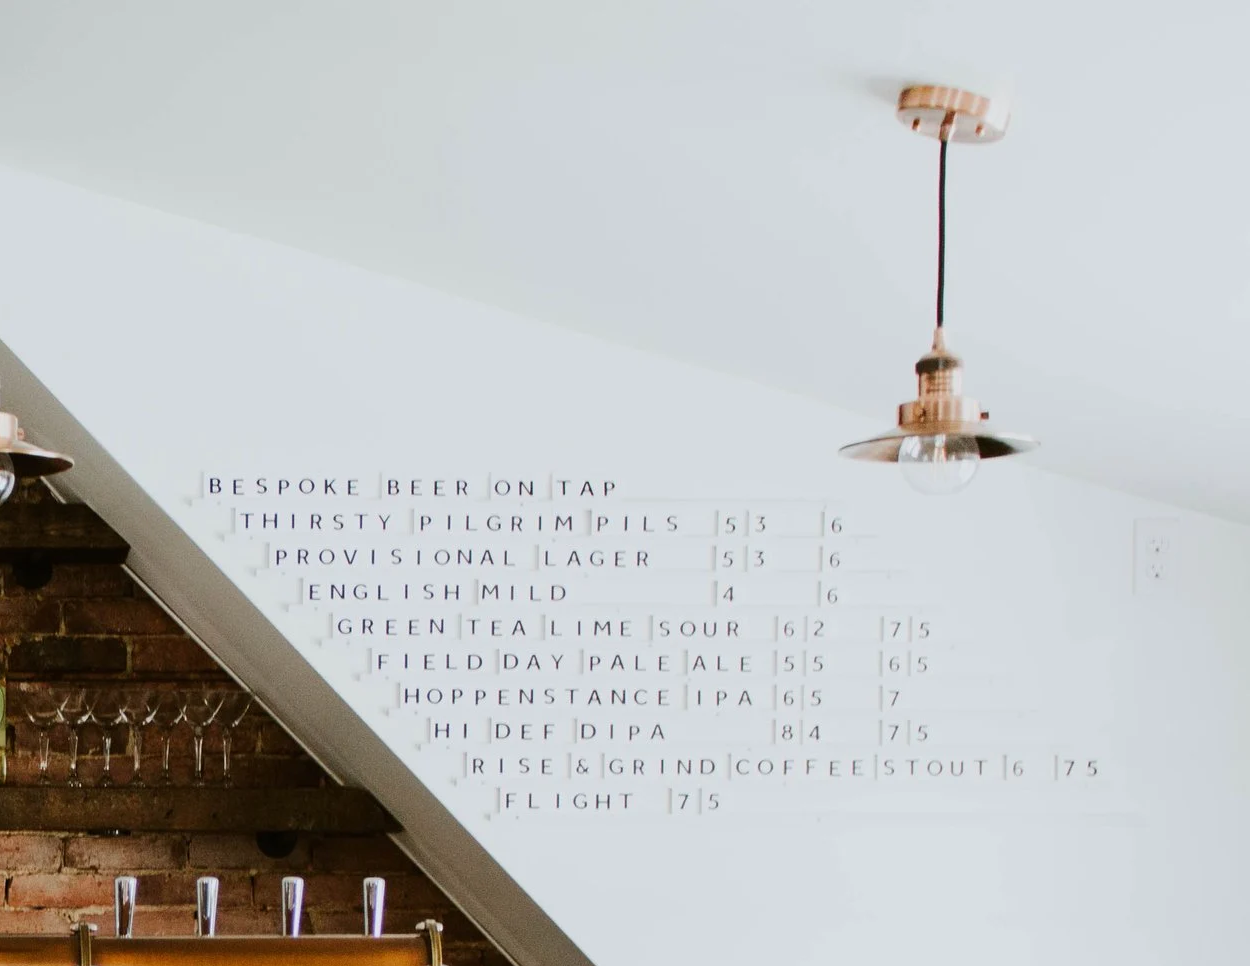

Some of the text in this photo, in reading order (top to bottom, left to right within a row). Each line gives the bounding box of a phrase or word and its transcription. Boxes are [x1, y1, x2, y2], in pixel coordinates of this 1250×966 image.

[210, 478, 615, 496] BESPOKE BEER ON TAP
[240, 513, 390, 530] THIRSTY
[420, 515, 572, 532] PILGRIM
[597, 516, 677, 532] PILS
[831, 518, 842, 533] 6
[276, 549, 515, 566] PROVISIONAL
[545, 550, 648, 567] LAGER
[830, 552, 840, 568] 6
[309, 584, 838, 604] ENGLISH MILD 4 6
[338, 618, 444, 635] GREEN
[467, 619, 526, 636] TEA
[551, 620, 631, 637] LIME
[660, 621, 738, 638] SOUR
[378, 653, 482, 670] FIELD
[504, 654, 563, 670] DAY
[590, 654, 669, 671] PALE
[693, 655, 751, 672] ALE
[405, 688, 669, 706] HOPPENSTANCE
[698, 690, 752, 706] IPA
[890, 690, 899, 707] 7
[435, 723, 467, 739] HI
[496, 723, 554, 740] DEF
[581, 723, 665, 741] DIPA
[473, 758, 552, 775] RISE
[576, 758, 589, 774] &
[609, 759, 715, 775] GRIND
[736, 759, 863, 776] COFFEE
[884, 759, 988, 776] STOUT
[1013, 760, 1024, 777] 6
[506, 793, 632, 810] FLIGHT
